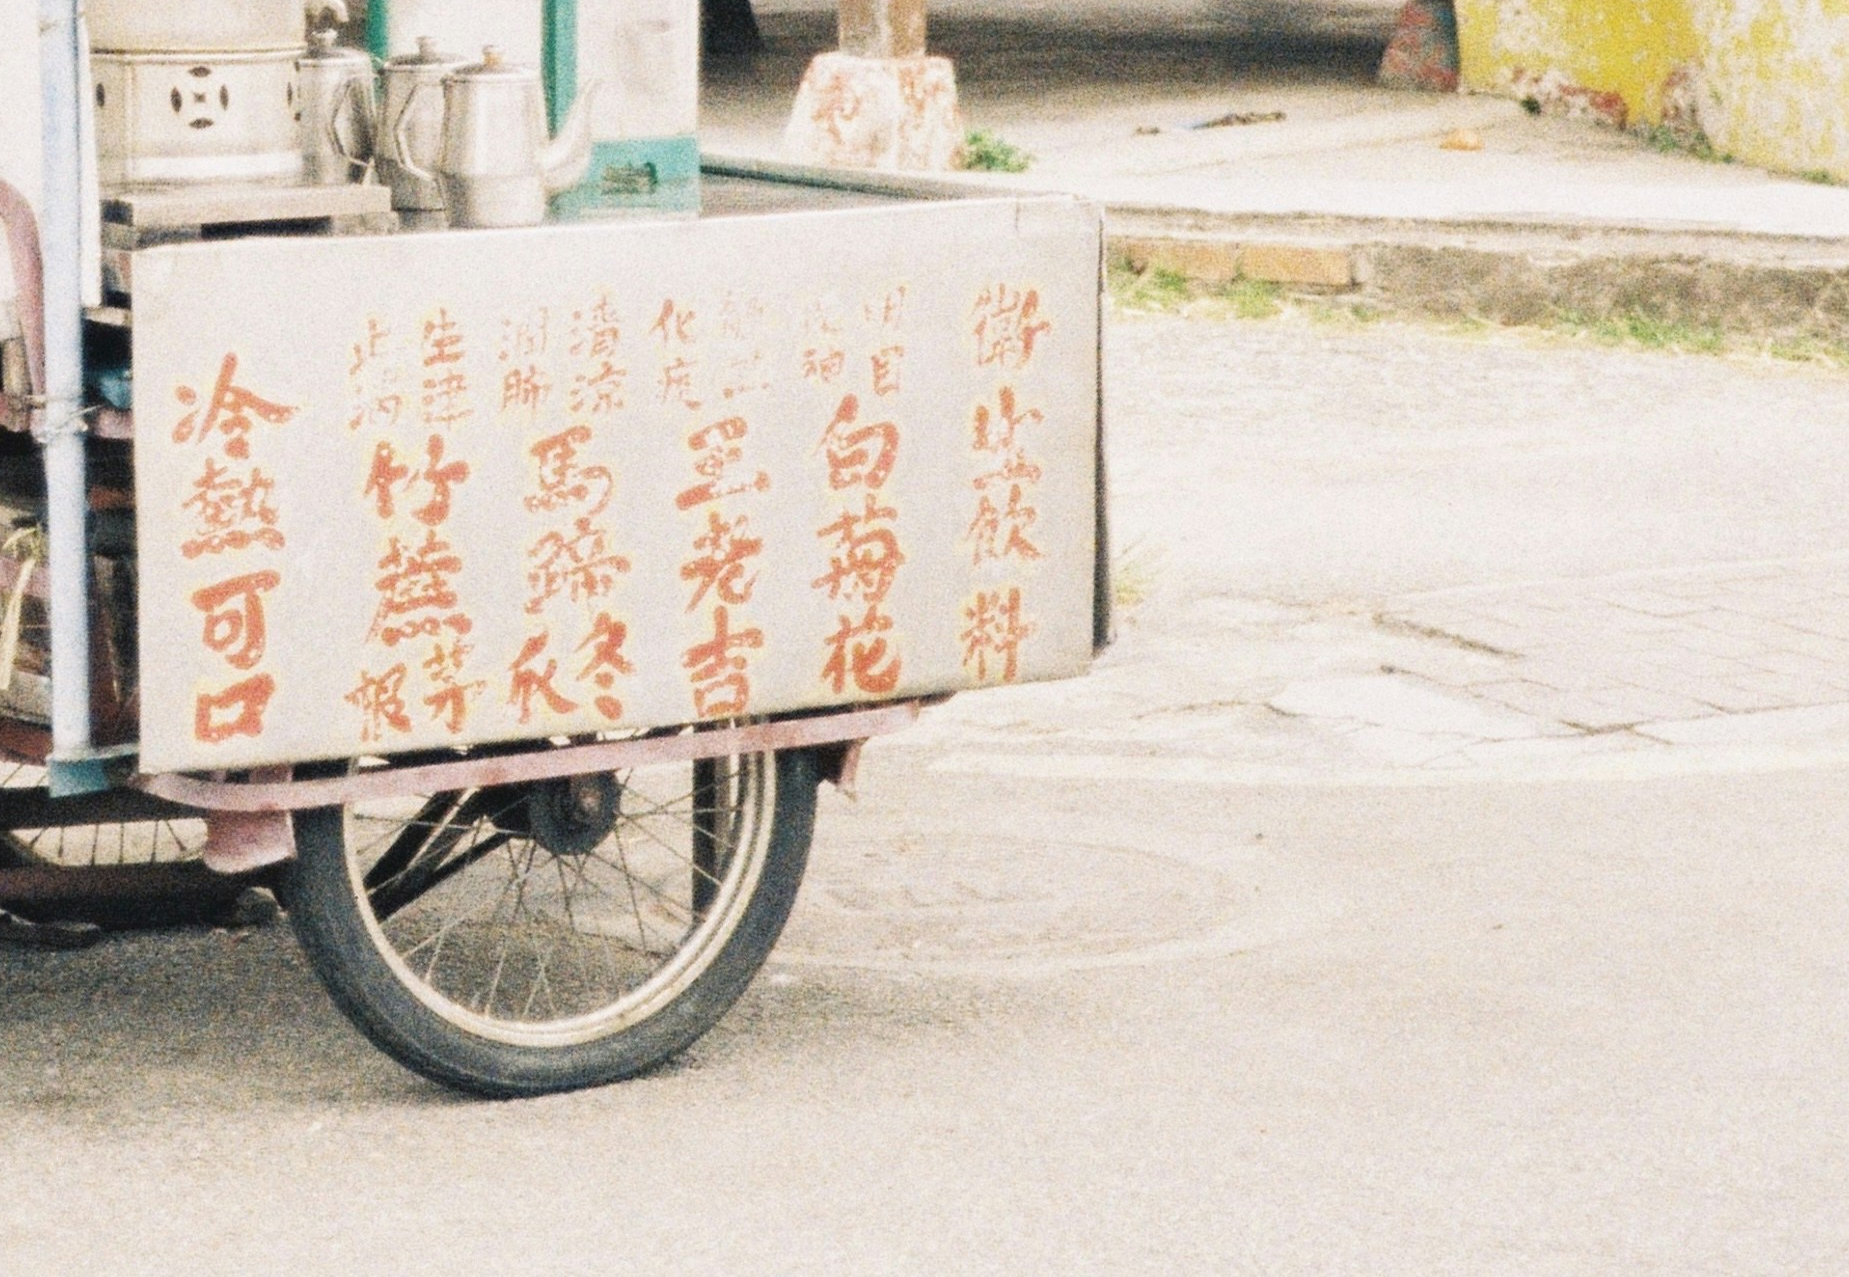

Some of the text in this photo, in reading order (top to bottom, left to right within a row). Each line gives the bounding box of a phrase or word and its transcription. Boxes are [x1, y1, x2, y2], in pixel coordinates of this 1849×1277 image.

[171, 351, 300, 743] 冷熱可口
[811, 392, 906, 695] 白菊花
